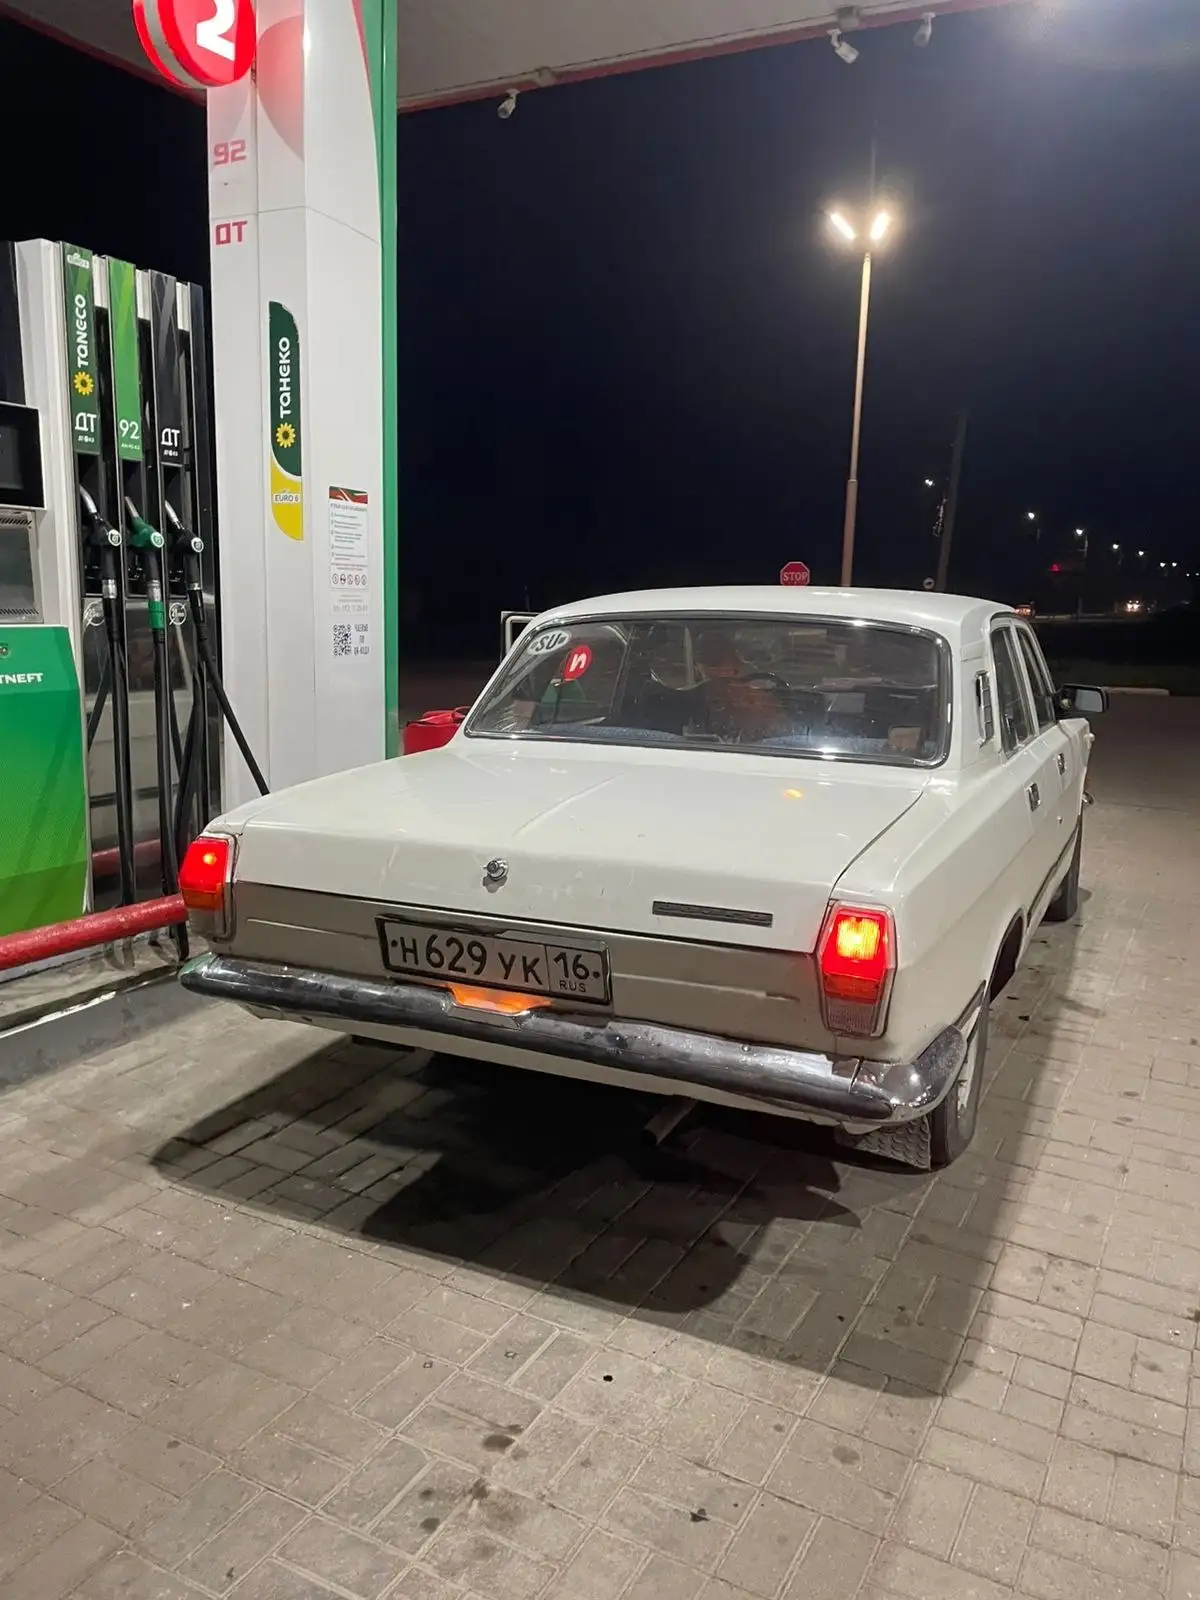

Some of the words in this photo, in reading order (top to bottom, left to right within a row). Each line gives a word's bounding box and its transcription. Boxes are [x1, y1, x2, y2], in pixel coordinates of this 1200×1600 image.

[213, 139, 247, 166] 92
[74, 412, 97, 433] ДТ
[119, 419, 140, 440] 92
[160, 428, 180, 447] ДТ
[783, 571, 808, 582] STOP
[535, 633, 561, 652] SU
[553, 951, 590, 980] 16
[559, 979, 587, 994] RUS
